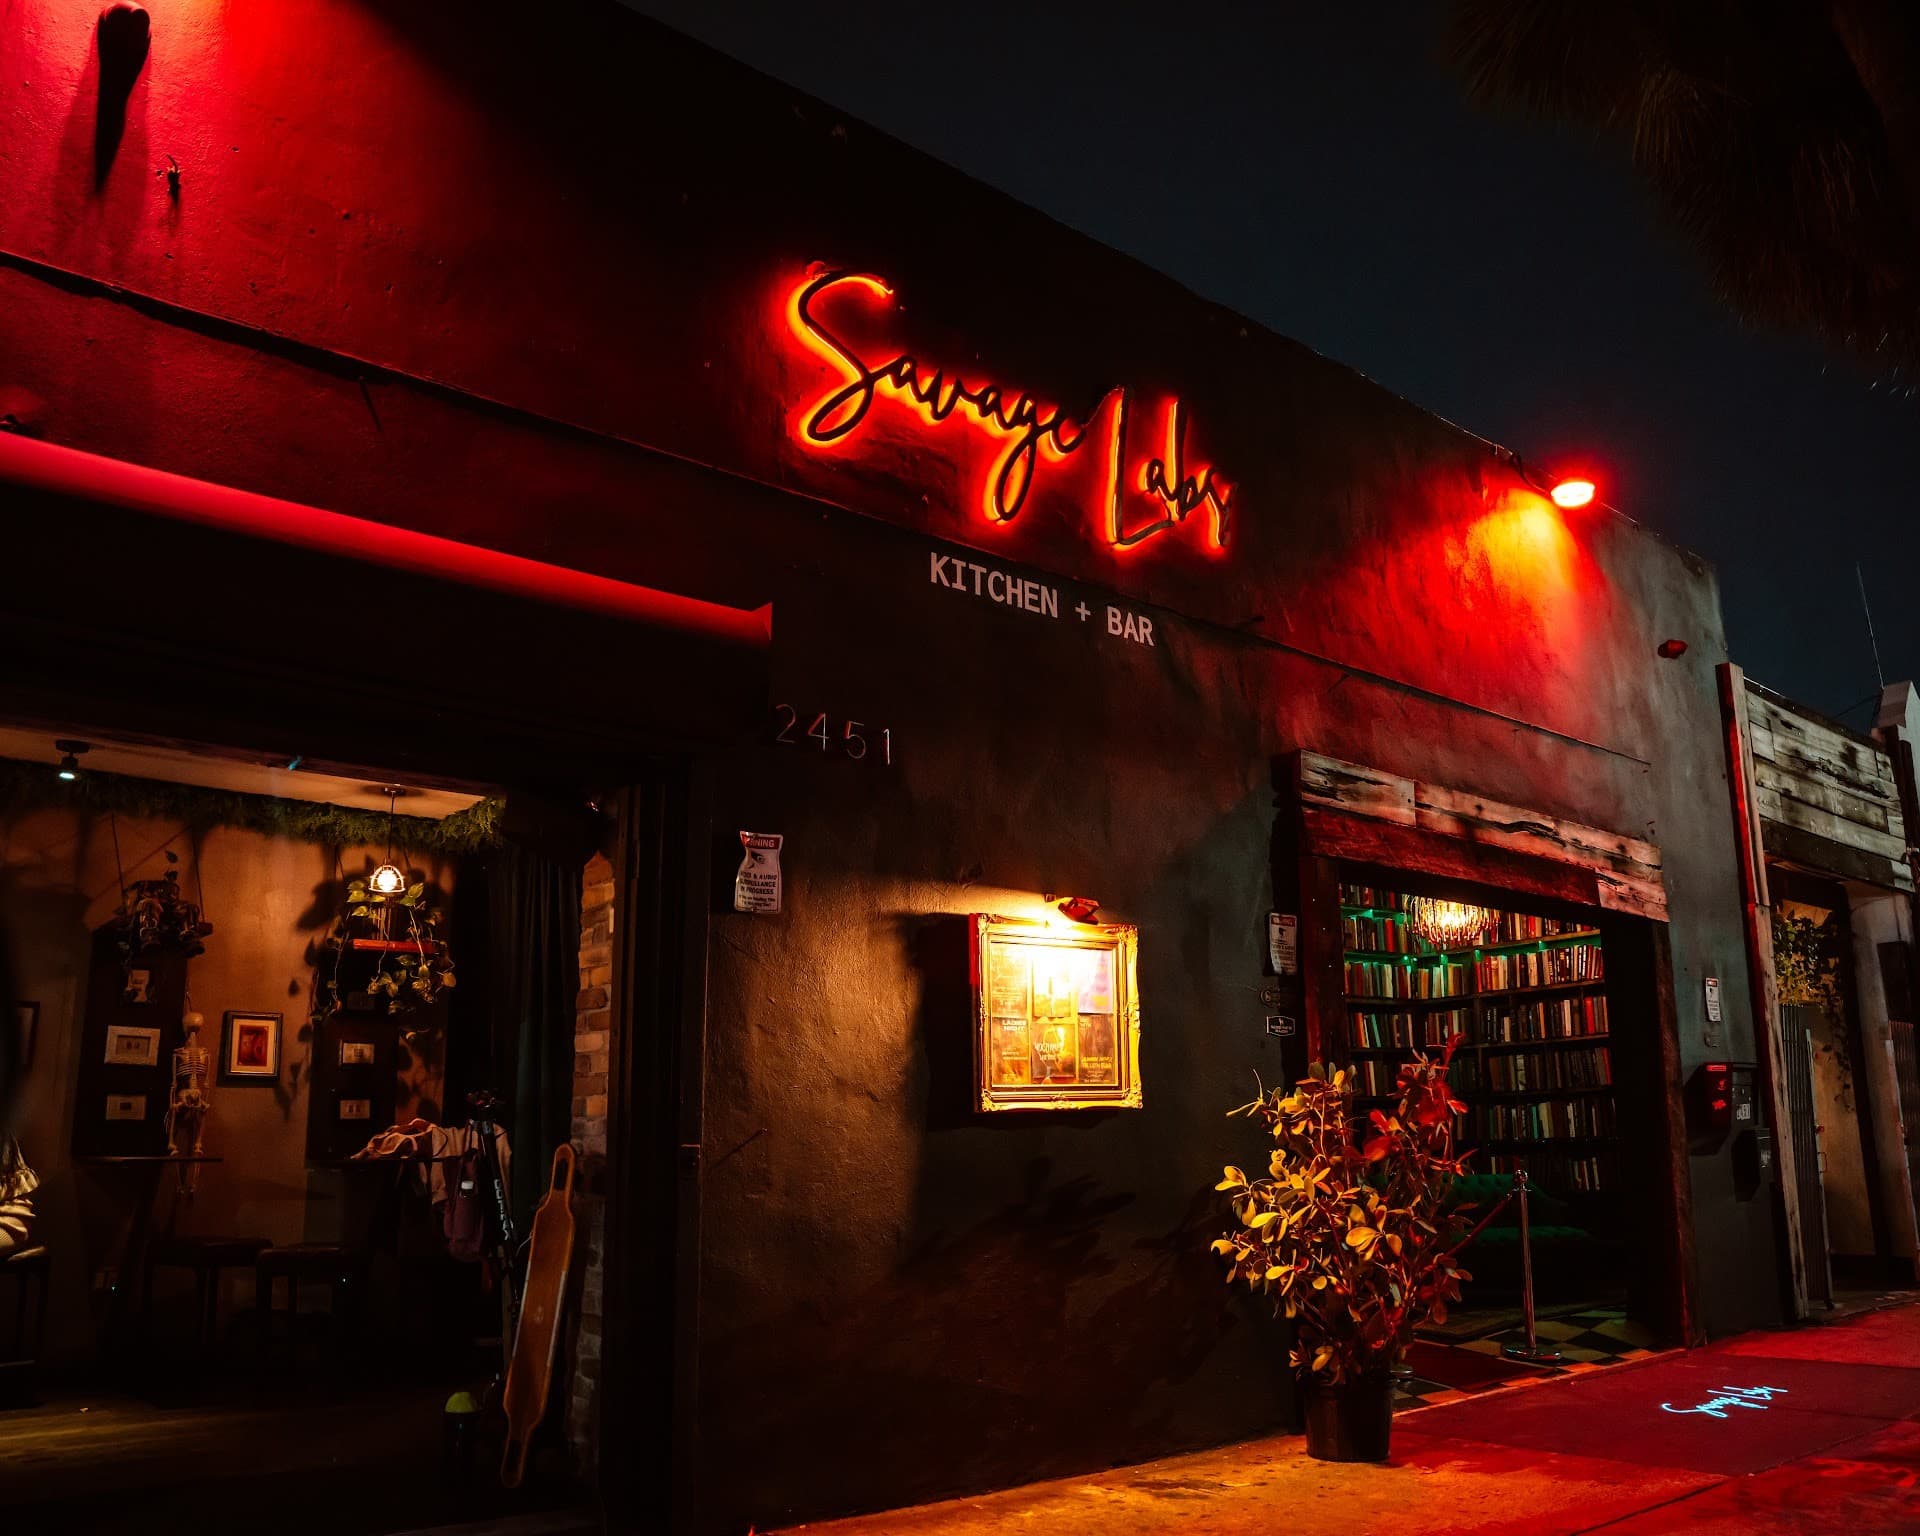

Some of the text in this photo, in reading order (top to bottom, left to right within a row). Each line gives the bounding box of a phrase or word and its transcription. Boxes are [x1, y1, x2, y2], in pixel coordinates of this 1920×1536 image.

[788, 270, 1238, 549] Savage Labs
[930, 551, 1155, 647] KITCHEN + BAR
[775, 702, 893, 767] 2451
